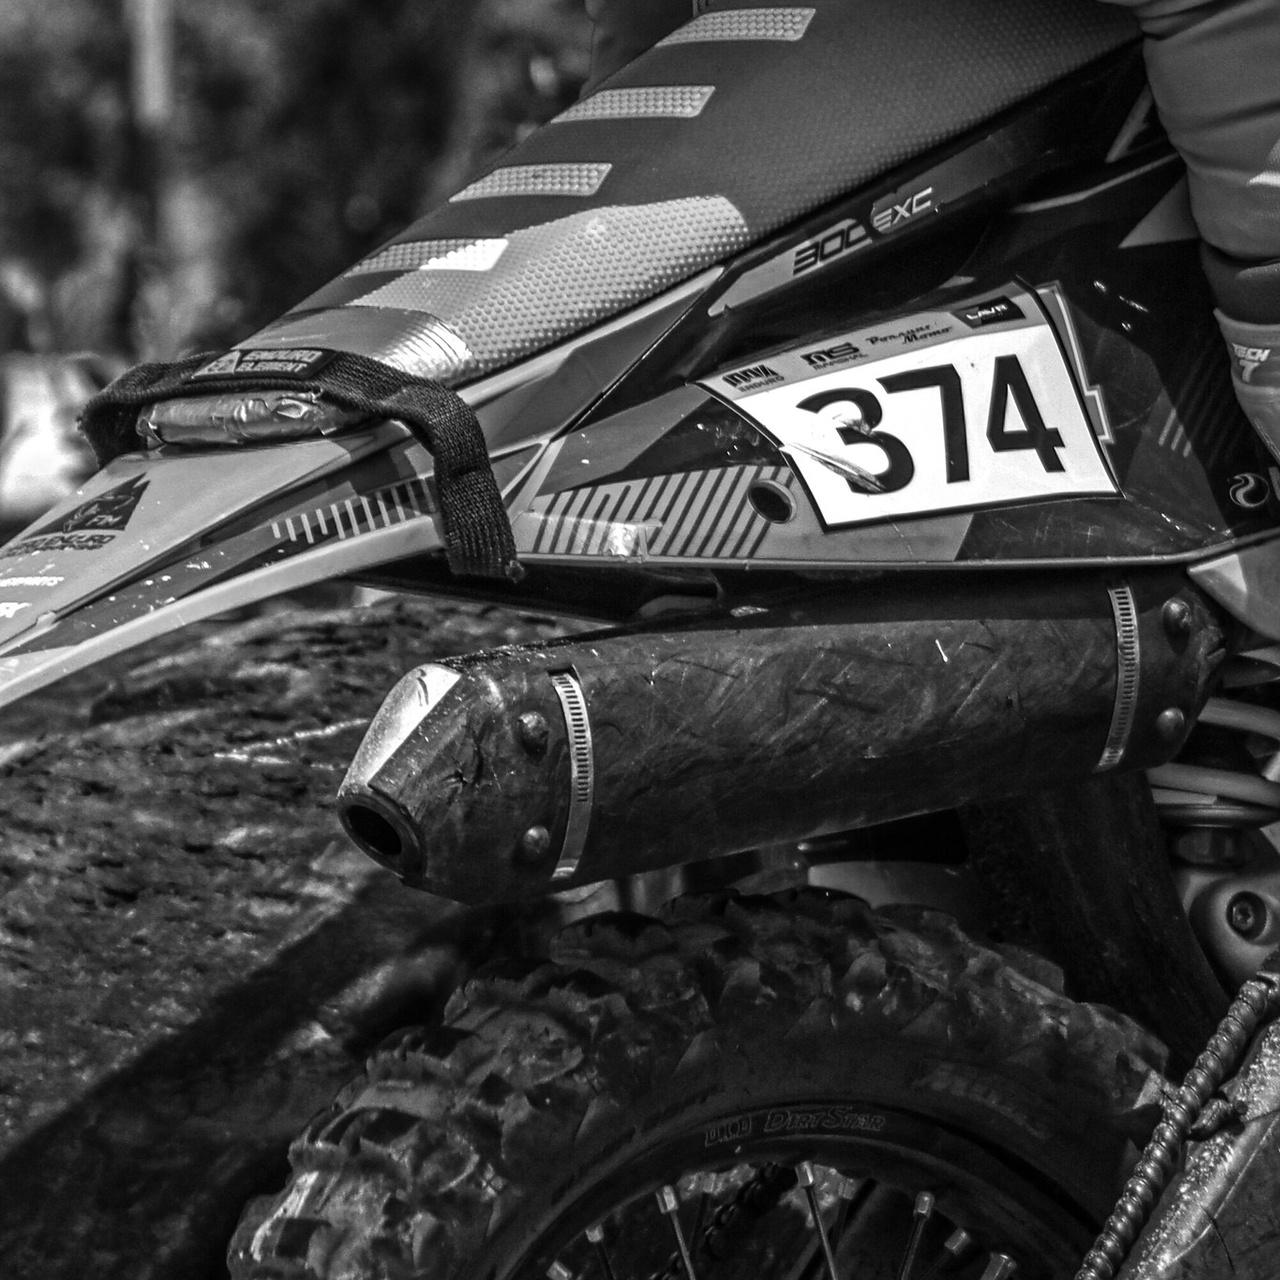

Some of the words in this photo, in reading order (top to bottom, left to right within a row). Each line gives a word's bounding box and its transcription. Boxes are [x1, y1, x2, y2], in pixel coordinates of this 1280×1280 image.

[872, 186, 933, 232] EXC
[1232, 342, 1271, 362] TECH
[1239, 359, 1260, 383] 7
[736, 375, 785, 393] ENDURO
[795, 353, 1066, 496] 374
